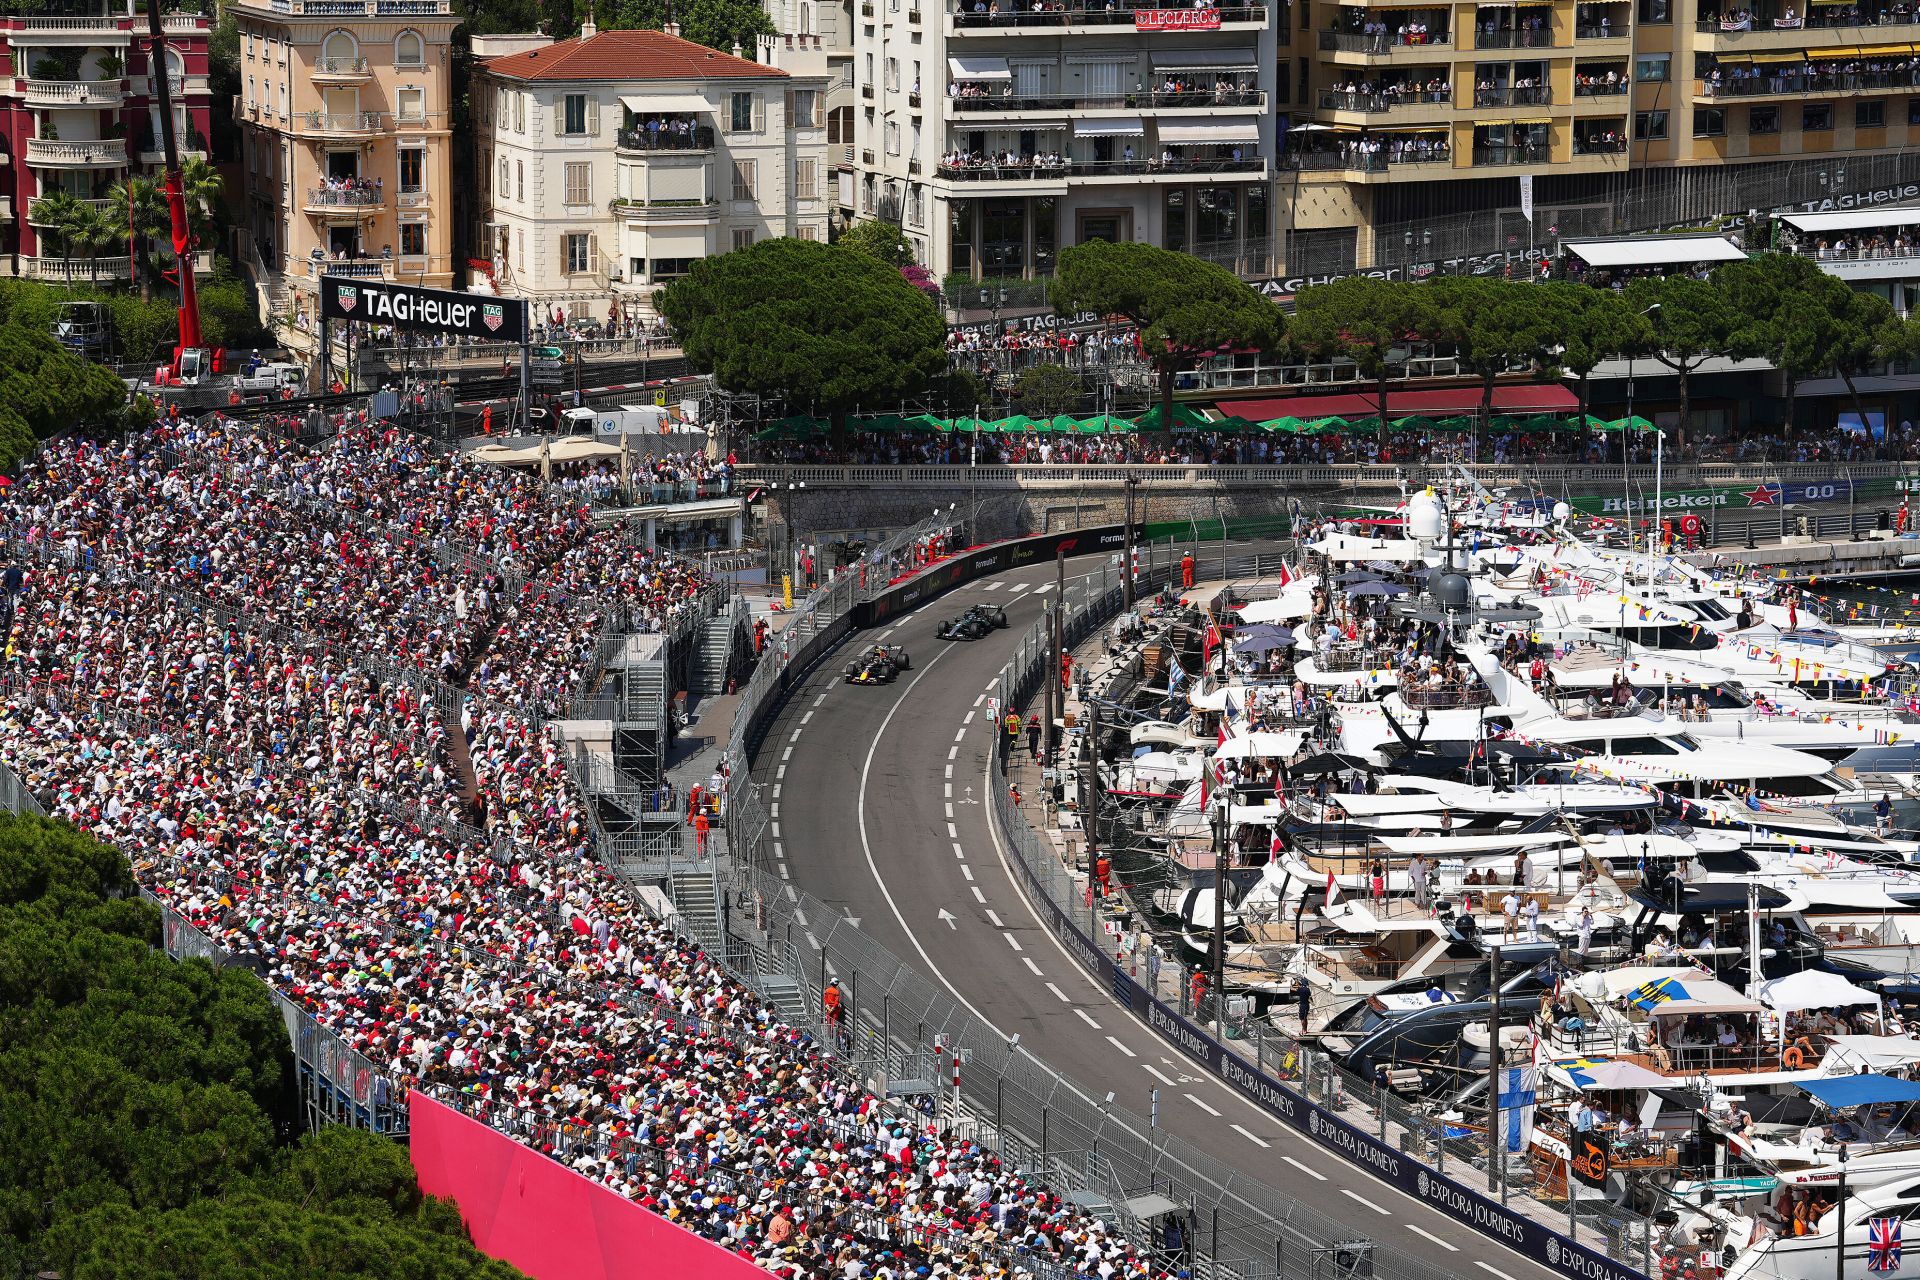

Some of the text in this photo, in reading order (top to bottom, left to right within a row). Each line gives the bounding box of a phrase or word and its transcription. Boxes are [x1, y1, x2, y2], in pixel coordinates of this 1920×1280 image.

[1148, 11, 1208, 25] LECLERC
[340, 288, 355, 297] TAG
[484, 306, 501, 315] TAG
[1804, 486, 1835, 499] 0.0
[1155, 1008, 1209, 1060] EXPLORA JOURNEYS
[1229, 1062, 1294, 1117] EXPLORA JOURNEYS
[1320, 1118, 1399, 1177] EXPLORA JOURNEYS
[1430, 1179, 1524, 1243] EXPLORA JOURNEYS
[1562, 1247, 1611, 1280] EXPLORA
